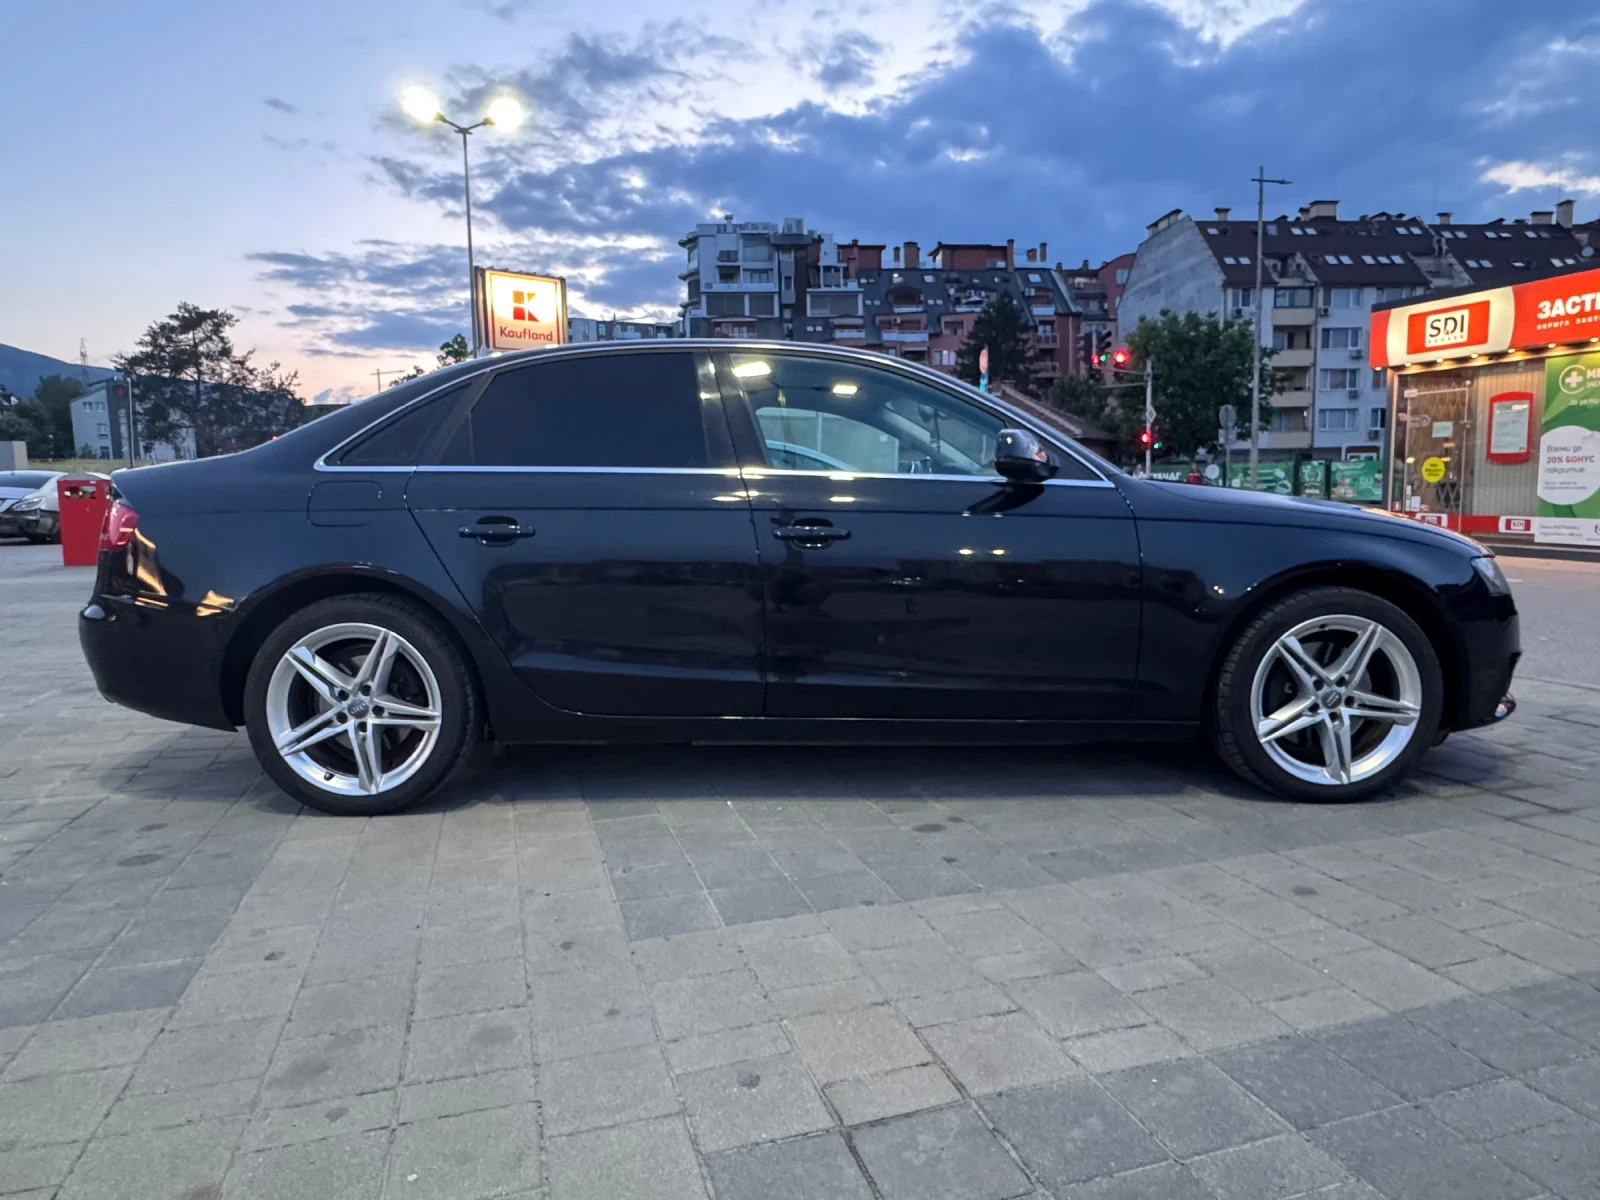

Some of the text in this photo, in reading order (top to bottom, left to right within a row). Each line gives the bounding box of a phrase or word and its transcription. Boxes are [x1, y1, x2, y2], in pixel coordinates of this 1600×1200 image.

[500, 326, 553, 341] Kaufland
[1429, 314, 1464, 338] SDI
[1547, 455, 1595, 464] 20% БОНУС
